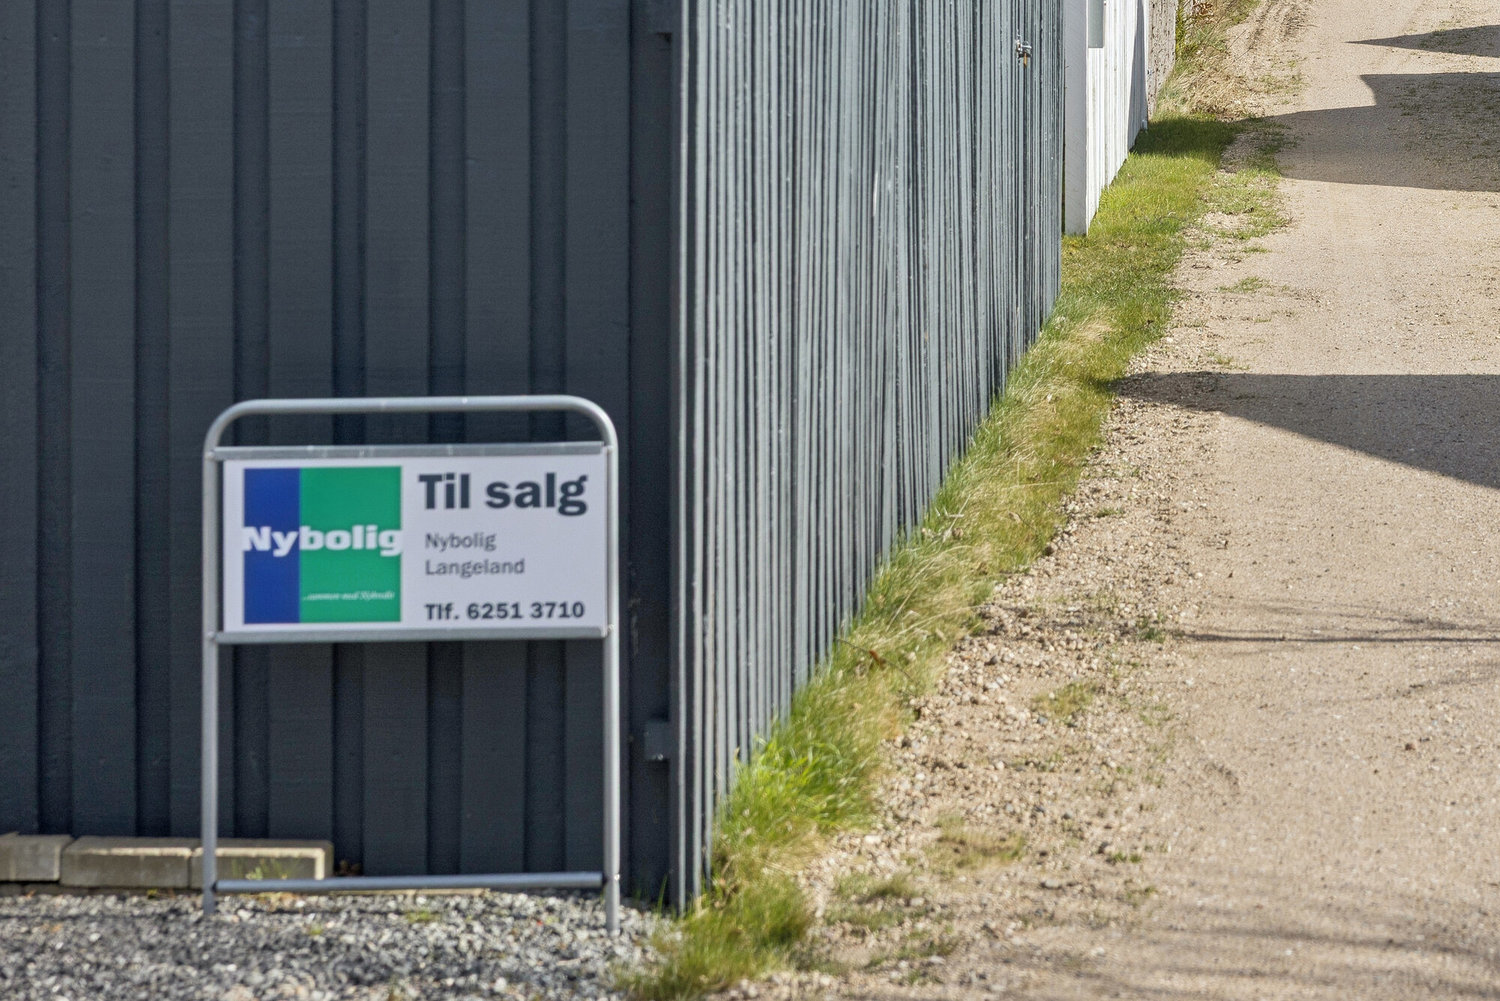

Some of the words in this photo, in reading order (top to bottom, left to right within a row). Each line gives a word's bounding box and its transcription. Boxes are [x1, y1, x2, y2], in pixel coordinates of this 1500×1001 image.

[418, 473, 469, 509] Til
[485, 473, 588, 516] salg
[243, 525, 402, 557] Nybolig
[424, 532, 497, 552] Nybolig
[424, 558, 526, 577] Langeland
[424, 604, 460, 620] Tlf.
[466, 603, 523, 619] 6251
[530, 602, 585, 618] 3710
